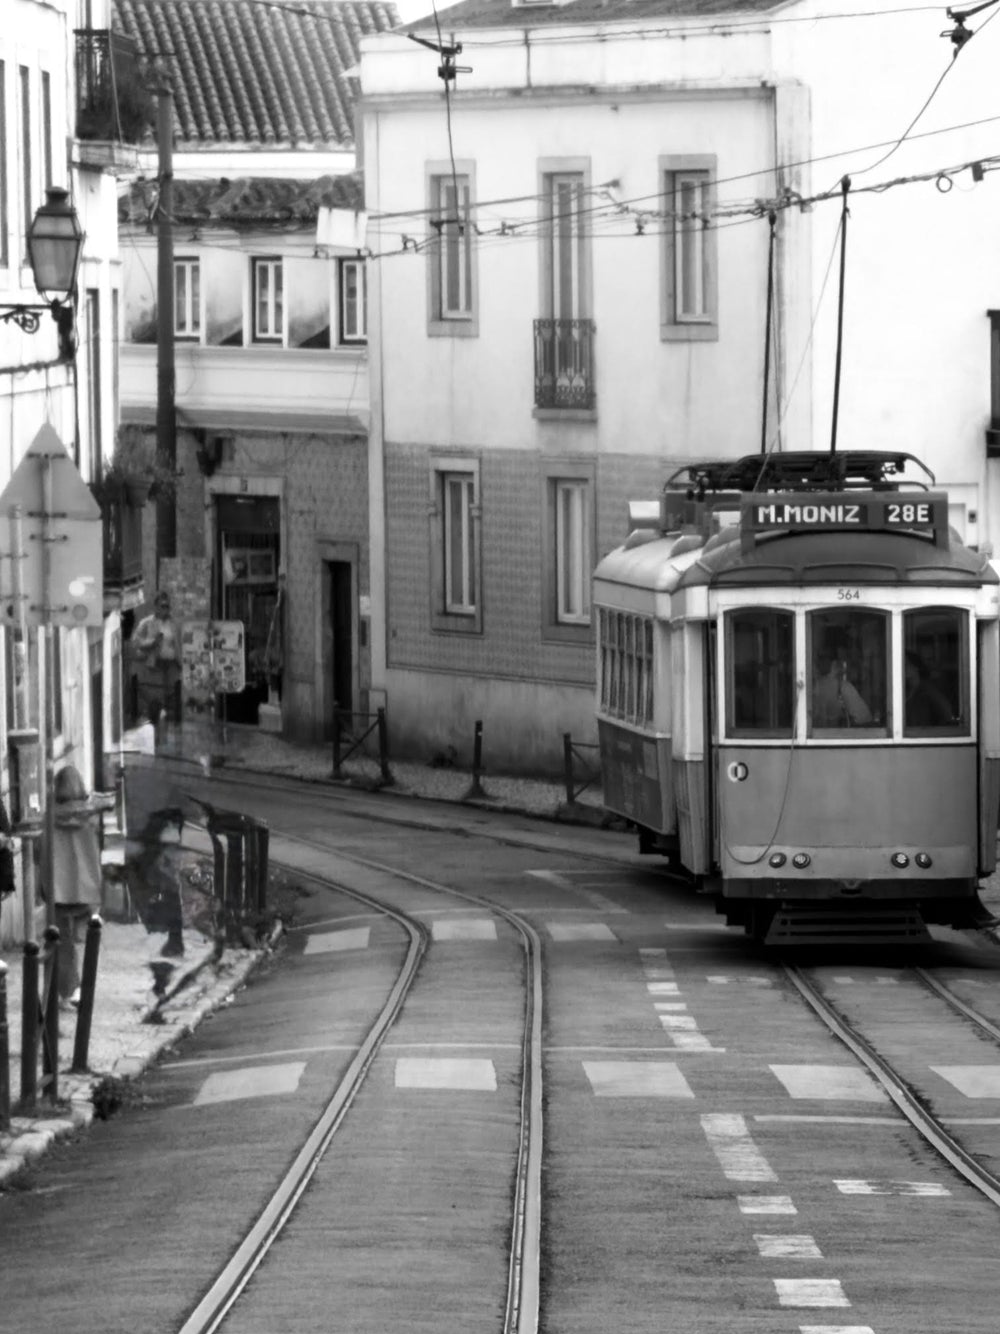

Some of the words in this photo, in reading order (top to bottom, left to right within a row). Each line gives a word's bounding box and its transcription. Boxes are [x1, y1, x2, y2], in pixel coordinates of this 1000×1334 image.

[758, 504, 860, 523] M.MONIZ
[888, 504, 929, 523] 28E
[837, 589, 860, 600] 564
